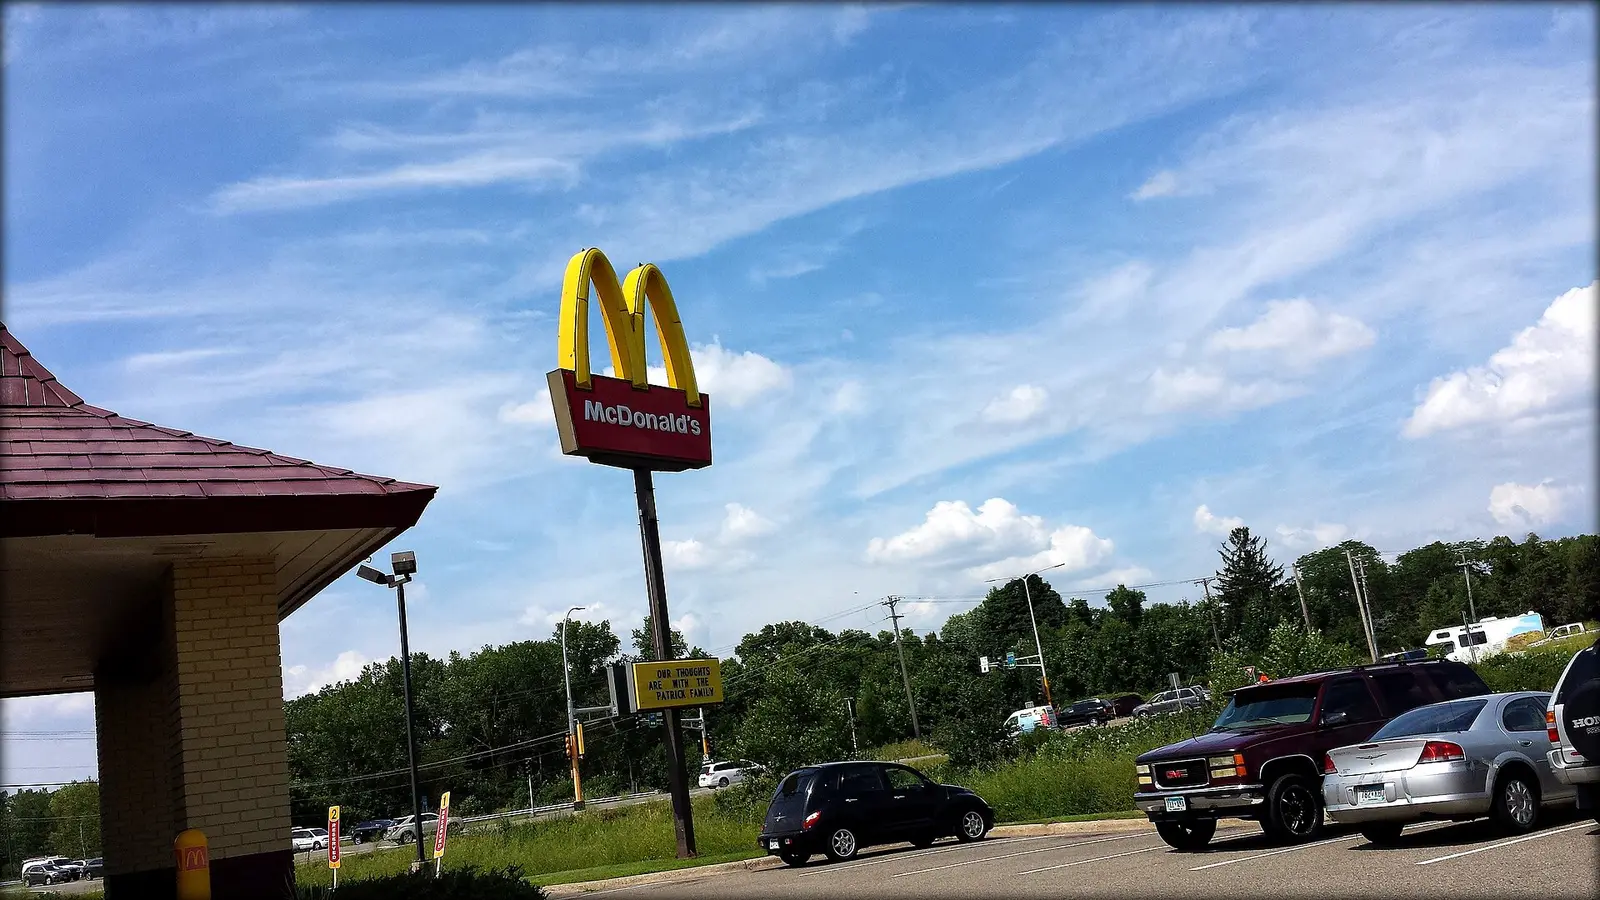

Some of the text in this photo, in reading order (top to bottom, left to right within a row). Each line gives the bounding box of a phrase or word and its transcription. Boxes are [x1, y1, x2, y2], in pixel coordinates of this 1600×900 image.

[584, 400, 701, 436] McDonald's
[656, 666, 711, 678] OUR THOUGHTS
[648, 677, 709, 690] ARE WITH THE
[656, 687, 714, 700] PATRICK FAMILY
[331, 808, 337, 819] 2
[437, 810, 445, 849] RESERVED
